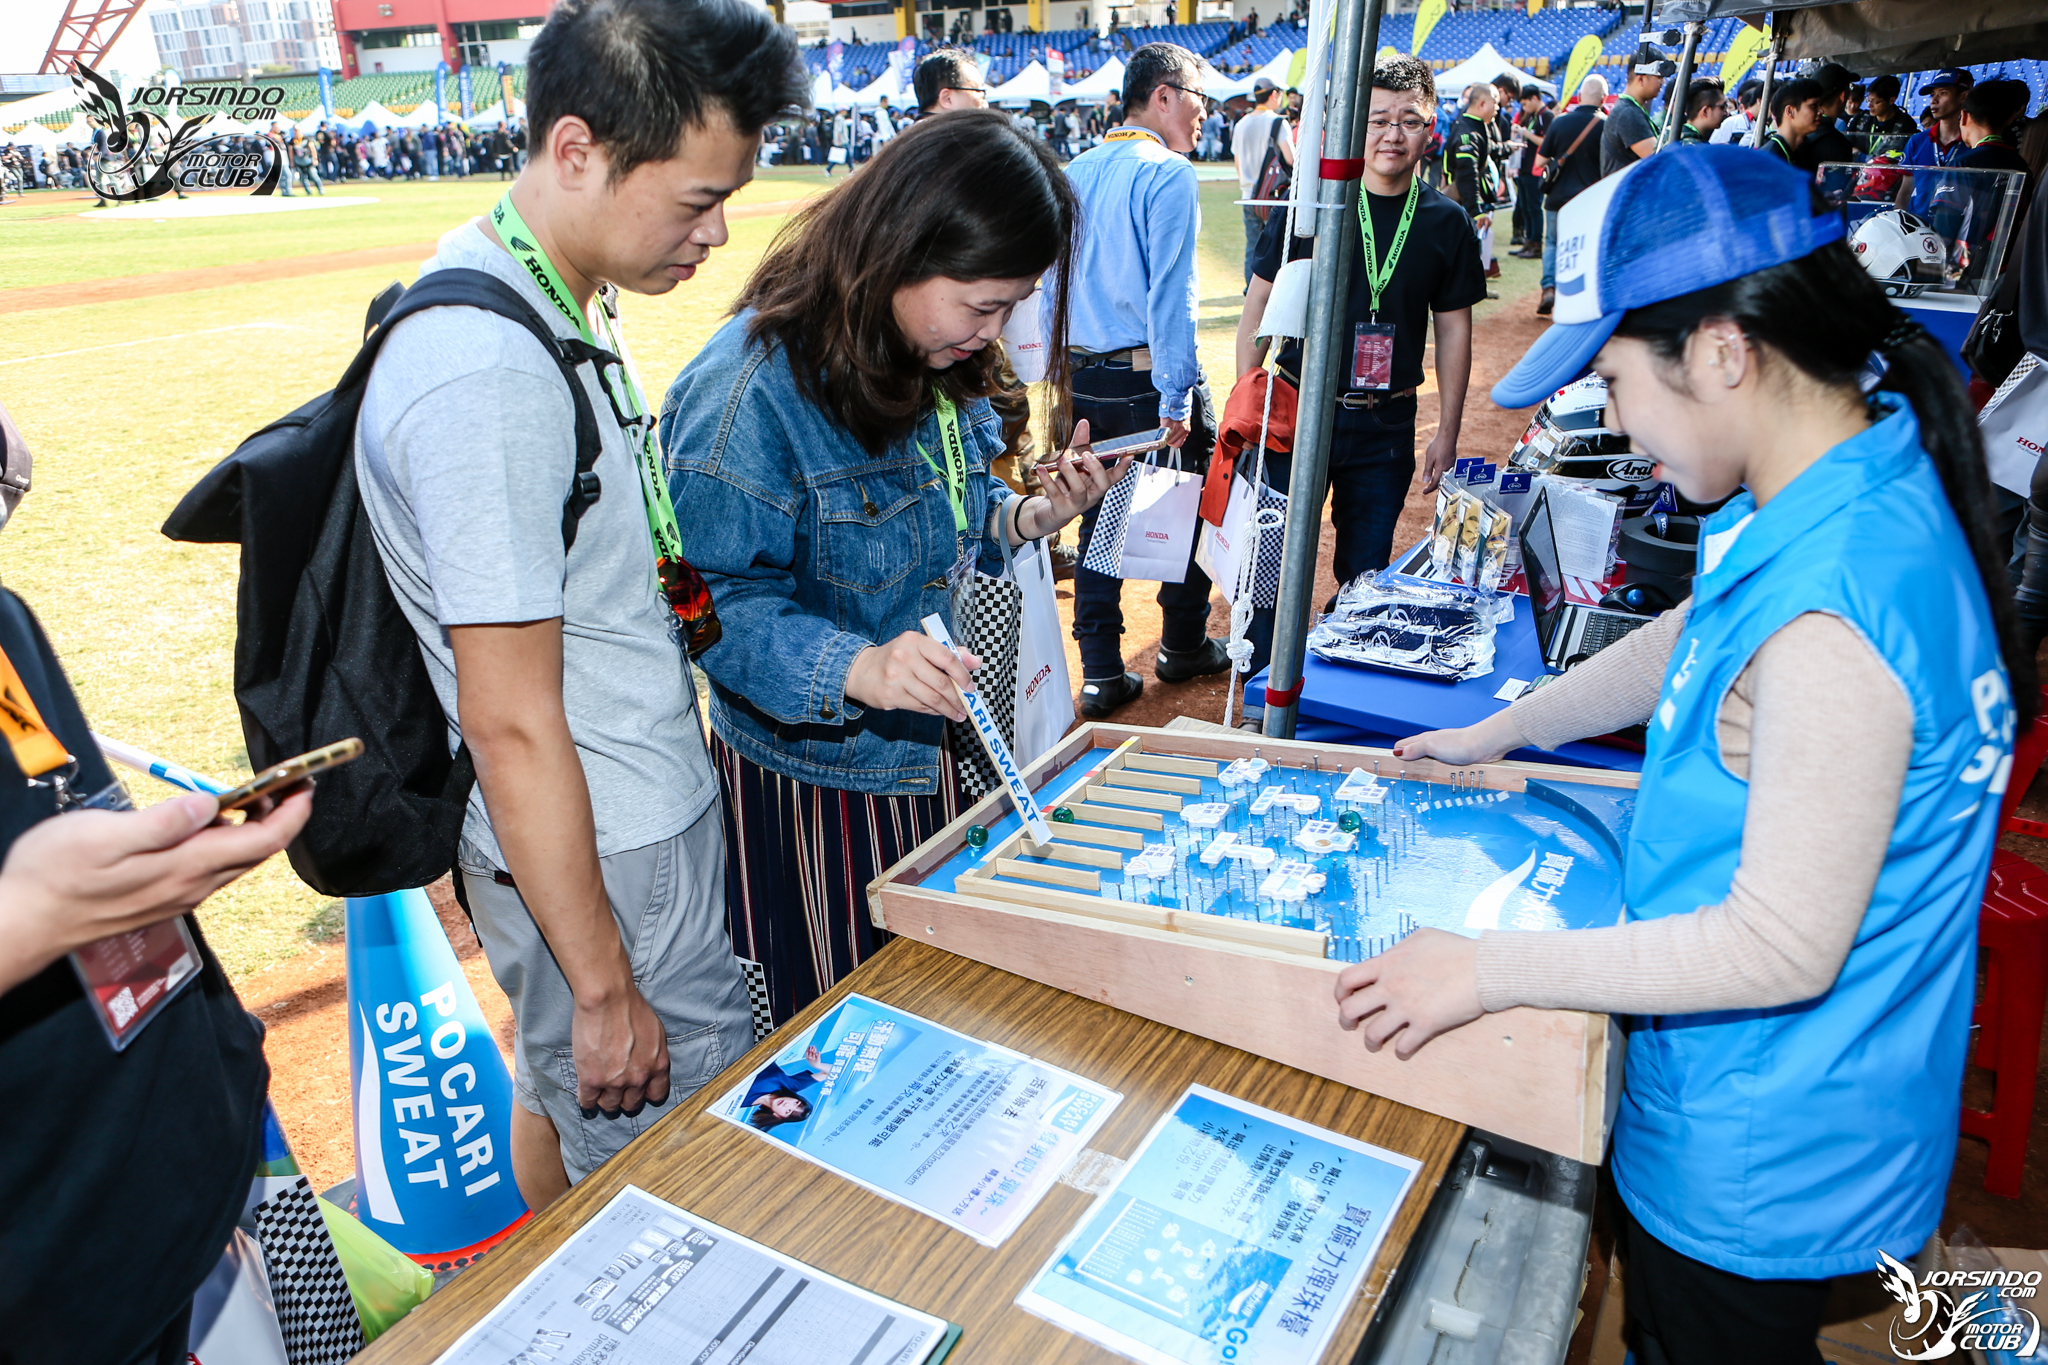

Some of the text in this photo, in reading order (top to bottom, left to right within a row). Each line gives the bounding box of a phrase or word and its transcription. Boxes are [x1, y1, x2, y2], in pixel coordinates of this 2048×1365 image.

[1391, 229, 1406, 261] HONDA
[523, 255, 581, 330] HONDA
[645, 437, 661, 501] ONDA
[947, 419, 964, 485] HONDA
[1145, 531, 1169, 540] HONDA
[1215, 530, 1230, 551] HONDA
[1024, 663, 1052, 701] HONDA
[986, 736, 1041, 825] SWEAT
[833, 1031, 865, 1059] 可能
[851, 1020, 896, 1074] 汗動無限
[376, 1001, 449, 1189] SWEAT
[420, 980, 501, 1197] POCARI
[1055, 1090, 1092, 1125] SWEAT
[866, 1095, 926, 1148] #汗動無限可能
[1061, 1094, 1101, 1132] POCARI
[699, 1339, 720, 1362] SOYJOY
[900, 1331, 926, 1362] POCARI
